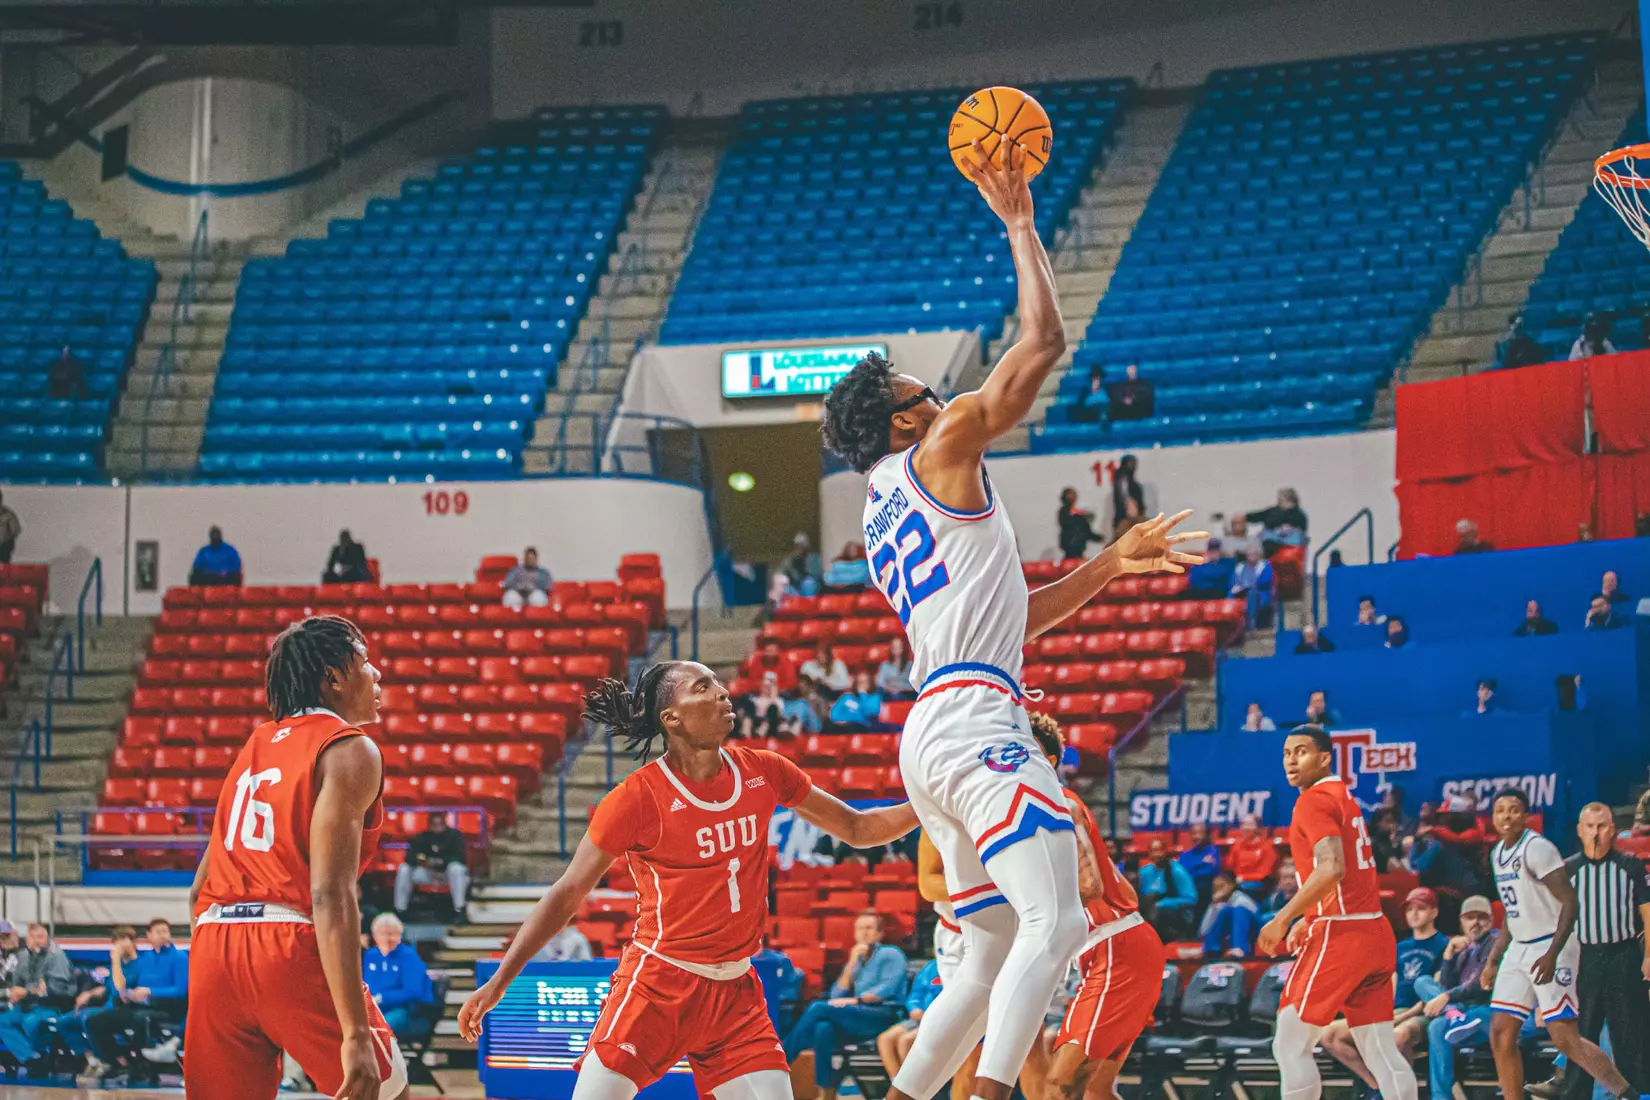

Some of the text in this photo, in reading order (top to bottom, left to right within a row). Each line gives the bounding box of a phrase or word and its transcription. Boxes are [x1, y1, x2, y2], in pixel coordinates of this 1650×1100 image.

[1092, 460, 1116, 486] 11
[422, 490, 469, 515] 109
[872, 509, 950, 629] 22
[224, 765, 282, 853] 16
[1130, 790, 1271, 826] STUDENT
[1442, 773, 1557, 812] SECTON
[696, 814, 757, 859] SUU
[1352, 815, 1376, 870] 2
[727, 857, 740, 913] 1
